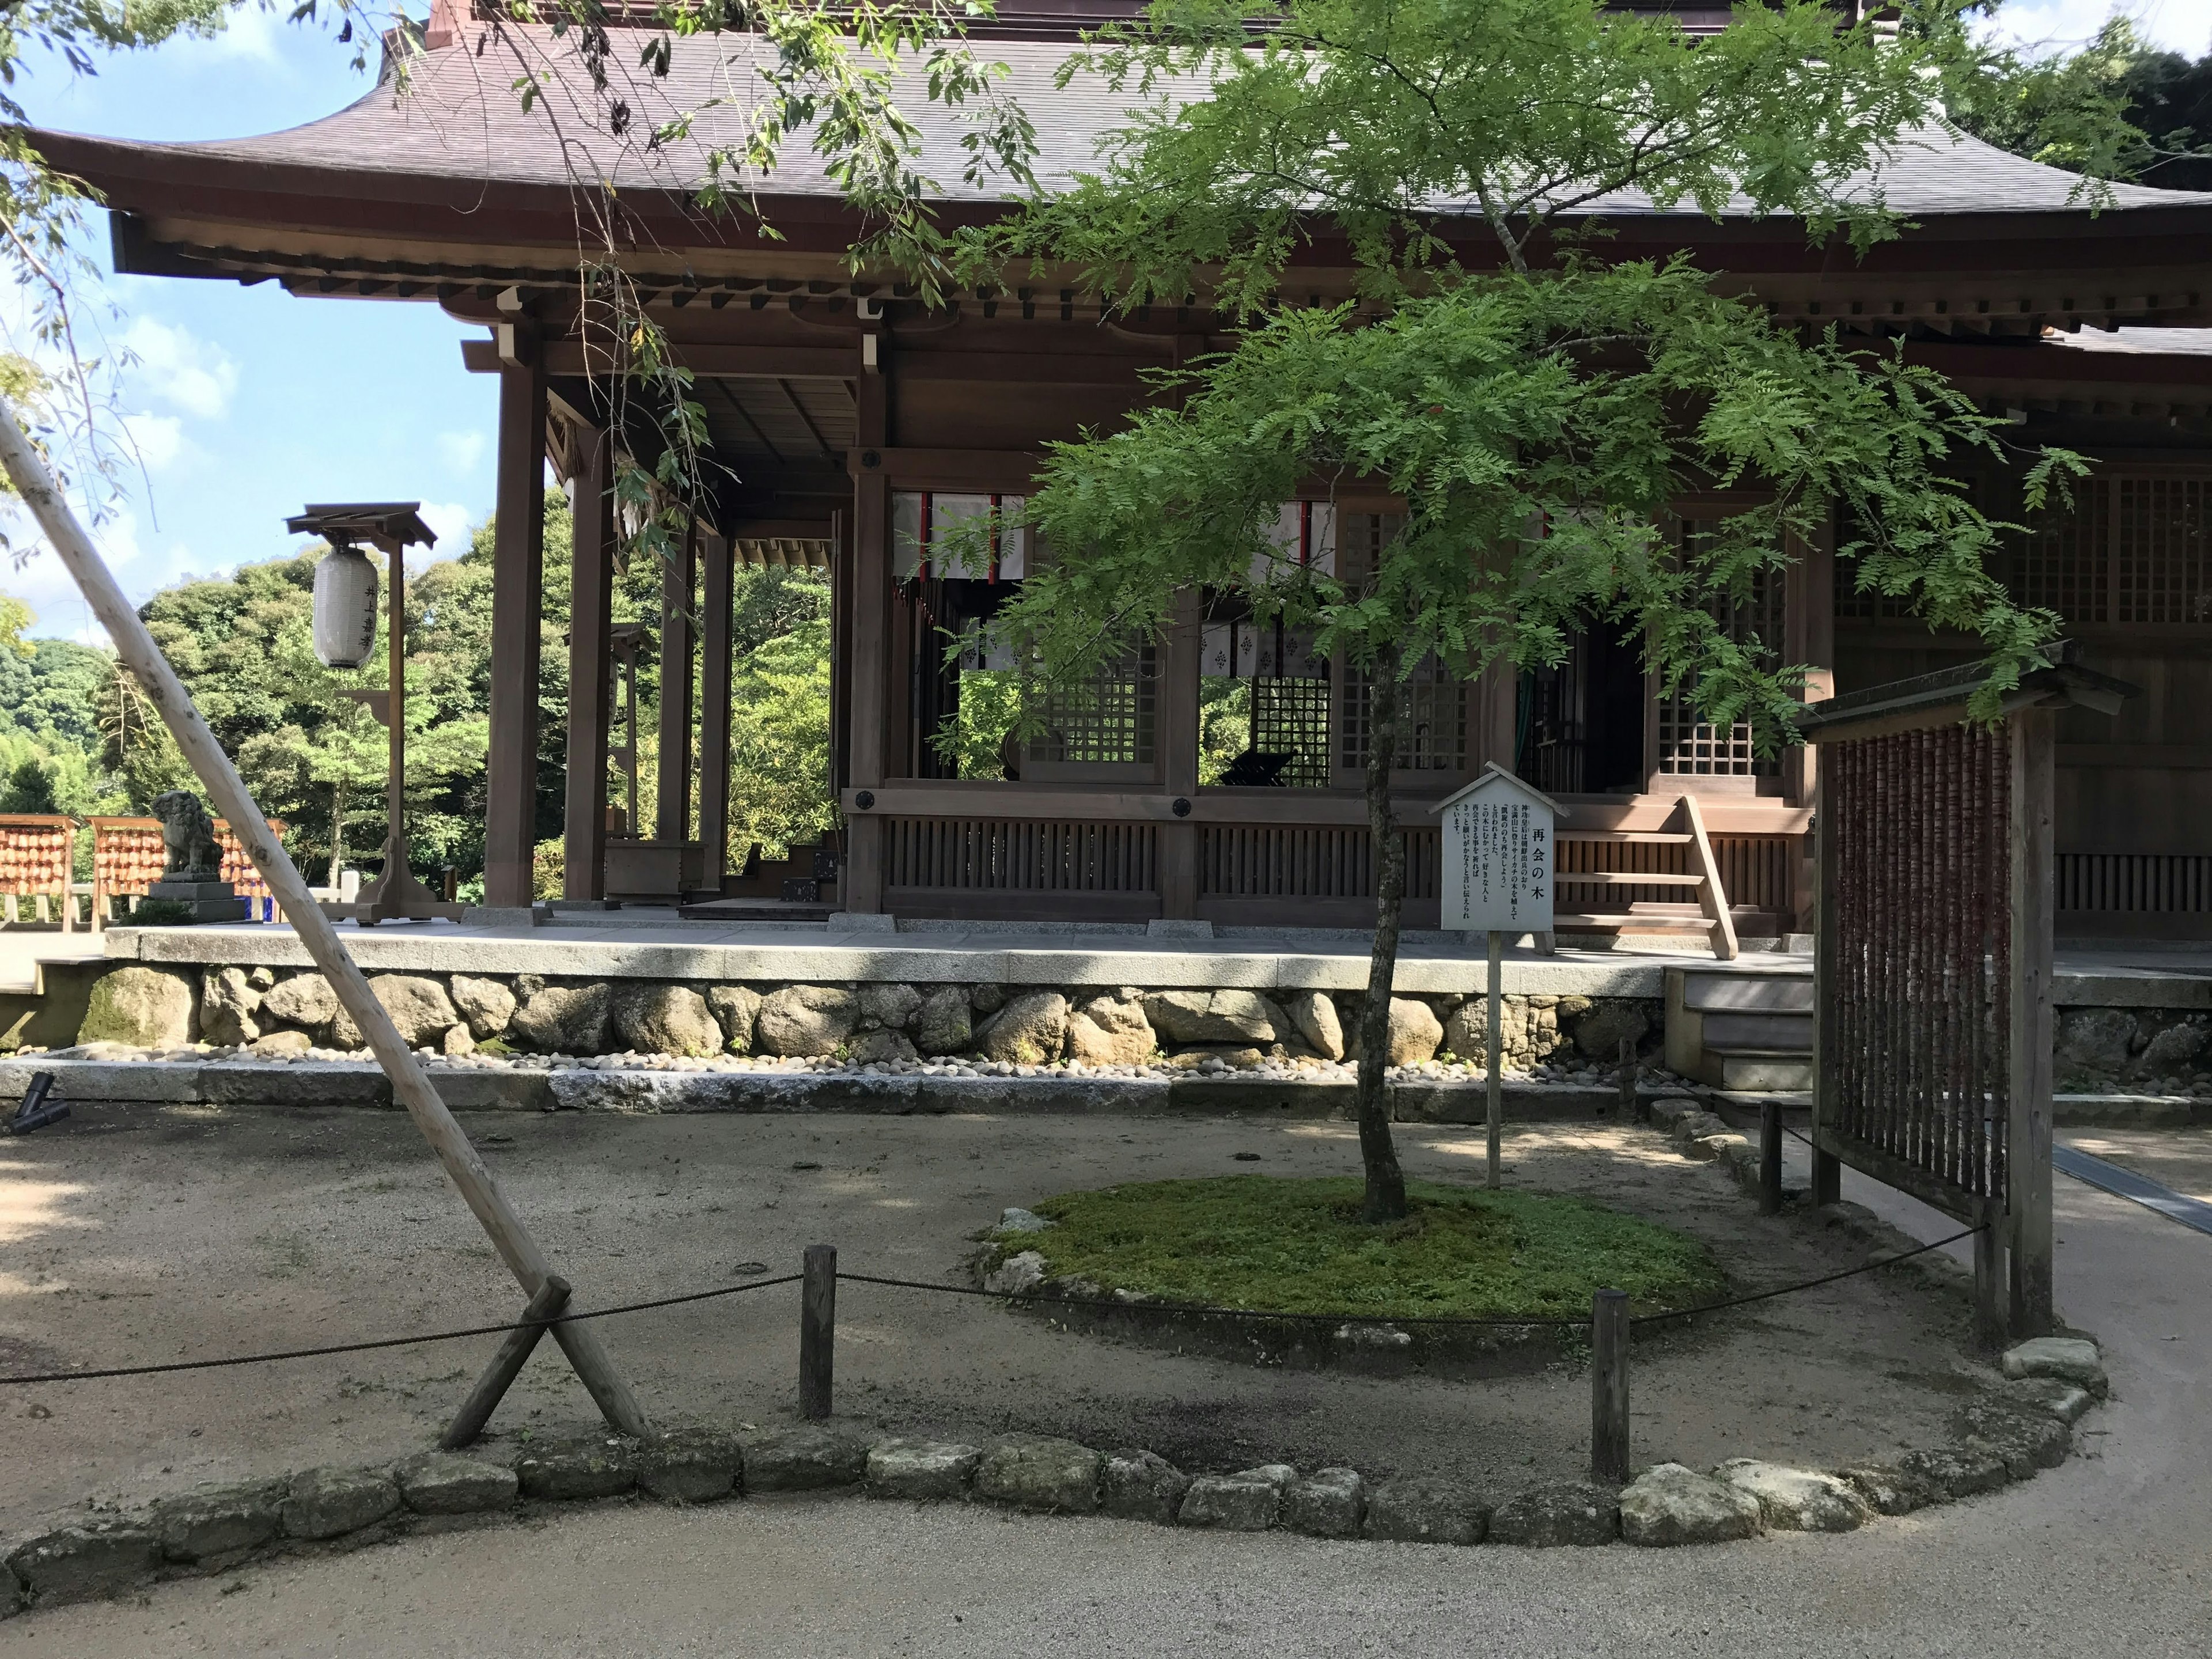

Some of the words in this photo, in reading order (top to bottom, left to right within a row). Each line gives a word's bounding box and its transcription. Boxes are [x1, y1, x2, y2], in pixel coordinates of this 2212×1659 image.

[1491, 804, 1499, 856] と言われました。
[1510, 804, 1518, 920] 宝満山に登りサイカチの木を植えて
[1520, 804, 1528, 890] 神功皇后は朝鮮出兵のおり
[1531, 828, 1544, 900] 再会の木
